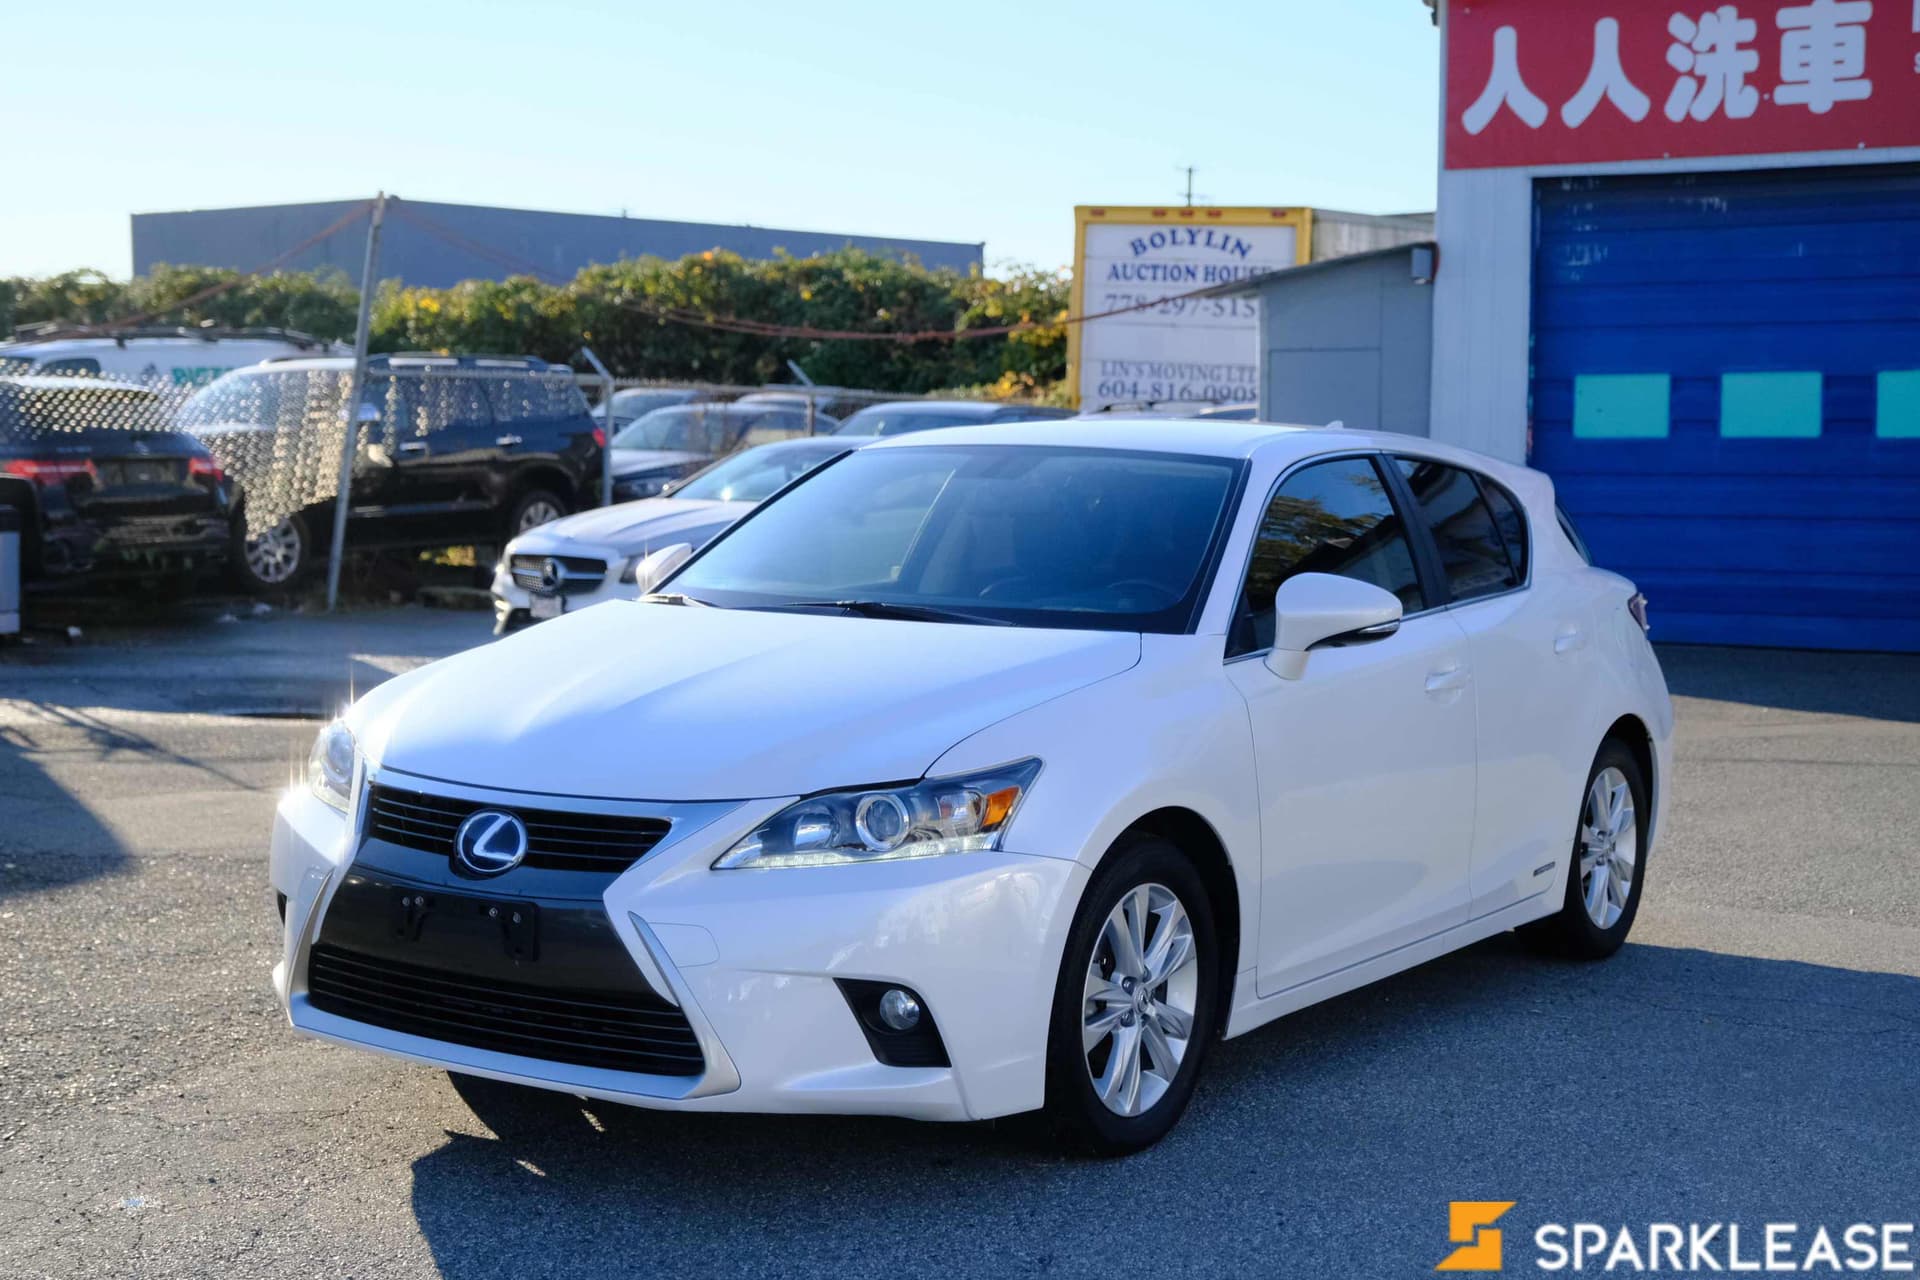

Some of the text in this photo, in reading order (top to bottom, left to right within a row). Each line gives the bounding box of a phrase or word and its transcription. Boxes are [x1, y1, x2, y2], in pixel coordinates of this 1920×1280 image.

[1461, 0, 1873, 135] 人人洗車
[1130, 227, 1252, 259] BOLYLIN
[1107, 264, 1197, 282] AUCTION
[1105, 293, 1257, 318] 778-297-515
[1149, 362, 1222, 383] MOVING
